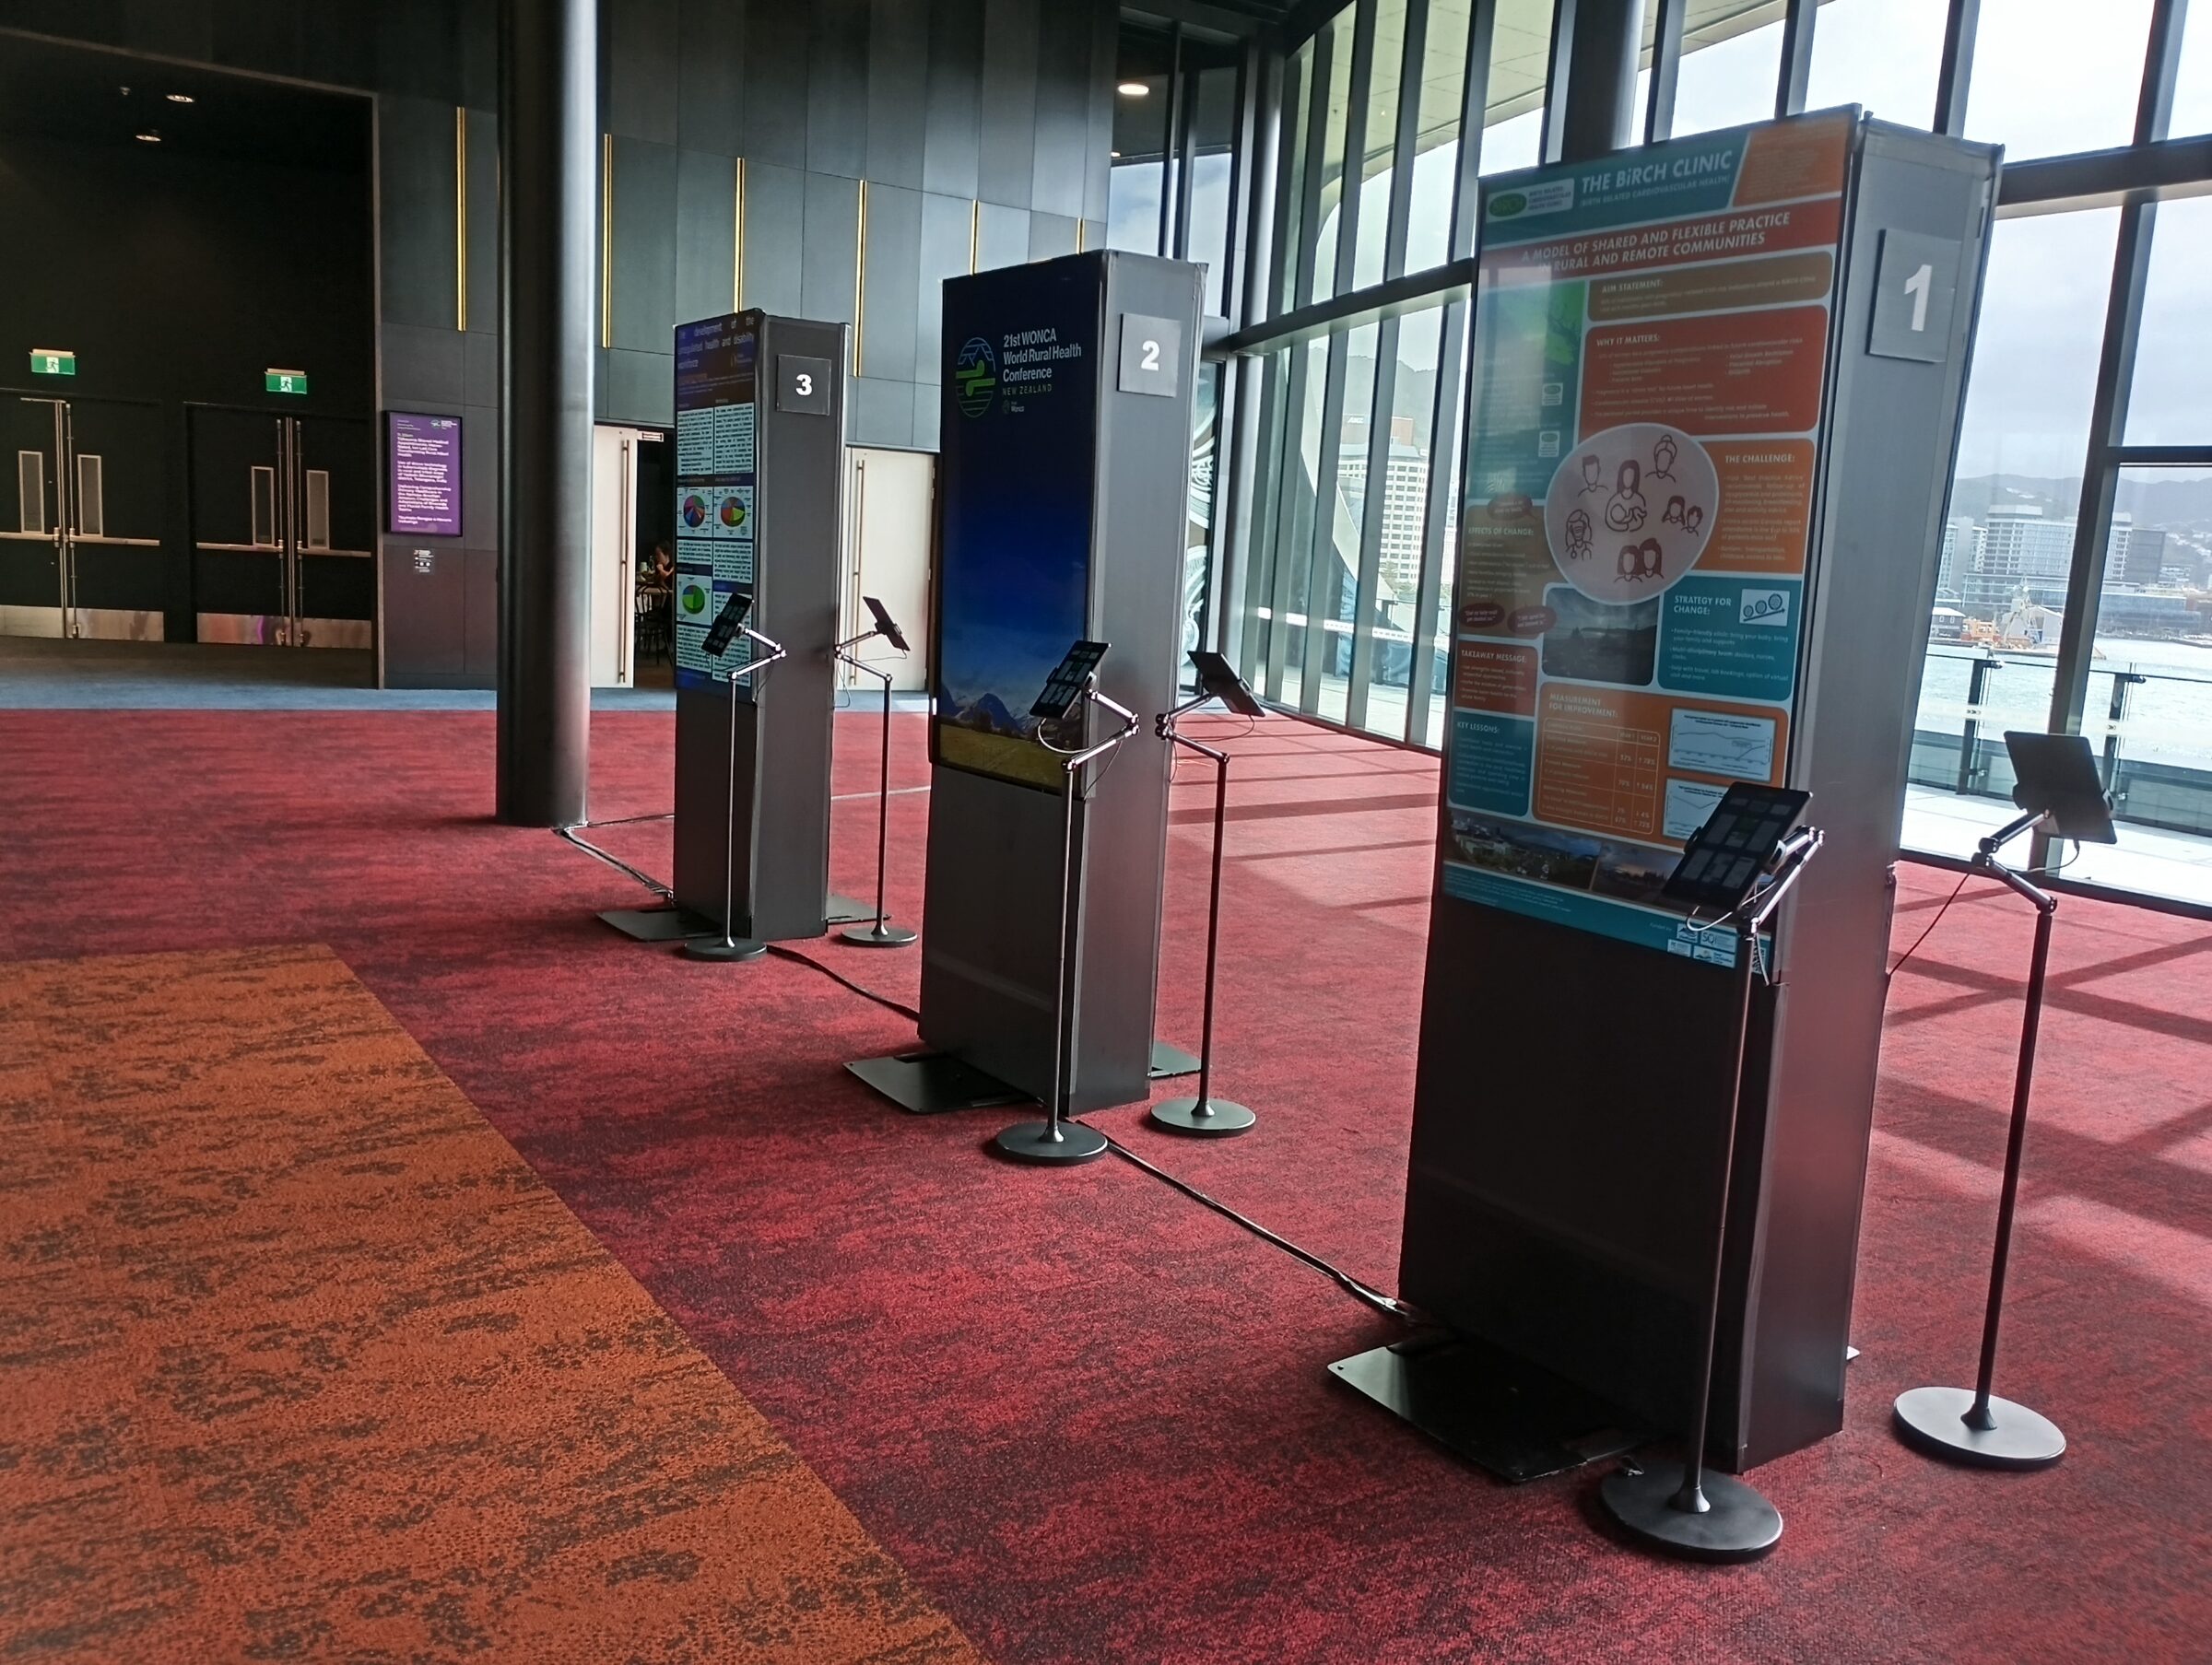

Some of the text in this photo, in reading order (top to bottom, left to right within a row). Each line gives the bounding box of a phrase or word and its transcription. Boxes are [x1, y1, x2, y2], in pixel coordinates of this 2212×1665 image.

[1582, 149, 1733, 193] THE BiRCH CLINIC
[1603, 191, 1630, 205] RELATED
[1632, 181, 1697, 199] CARDIOVASCULAR
[1522, 212, 1790, 263] A MODEL OF SHARED AND FLEXIBLE PRACTICE
[1554, 257, 1590, 272] RURAL
[1593, 253, 1618, 267] AND
[1622, 247, 1669, 264] REMOTE
[1674, 232, 1765, 256] COMMUNITIES
[1602, 278, 1665, 293] AIM STATEMENT:
[1904, 264, 1932, 331] 1
[731, 318, 736, 329] of
[746, 316, 755, 326] the
[722, 337, 731, 347] and
[1004, 327, 1056, 347] 21st WONCA
[1597, 334, 1660, 346] WHY IT MATTERS:
[1004, 343, 1082, 365] World Rural Health
[1141, 340, 1159, 371] 2
[1003, 368, 1053, 382] Conference
[795, 374, 812, 395] 3
[1003, 383, 1053, 396] NEW ZEALAND
[1724, 452, 1795, 464] THE CHALLENGE:
[1468, 526, 1492, 534] EFFECTS
[1504, 527, 1534, 536] CHANGE:
[1674, 594, 1732, 607] STRATEGY FOR
[1673, 604, 1711, 616] CHANGE:
[1461, 649, 1527, 663] TAKEAWAY MESSAGE:
[1549, 693, 1601, 706] MEASUREMENT
[1548, 701, 1618, 718] FOR IMPROVEMENT:
[1457, 721, 1500, 734] KEY LESSONS:
